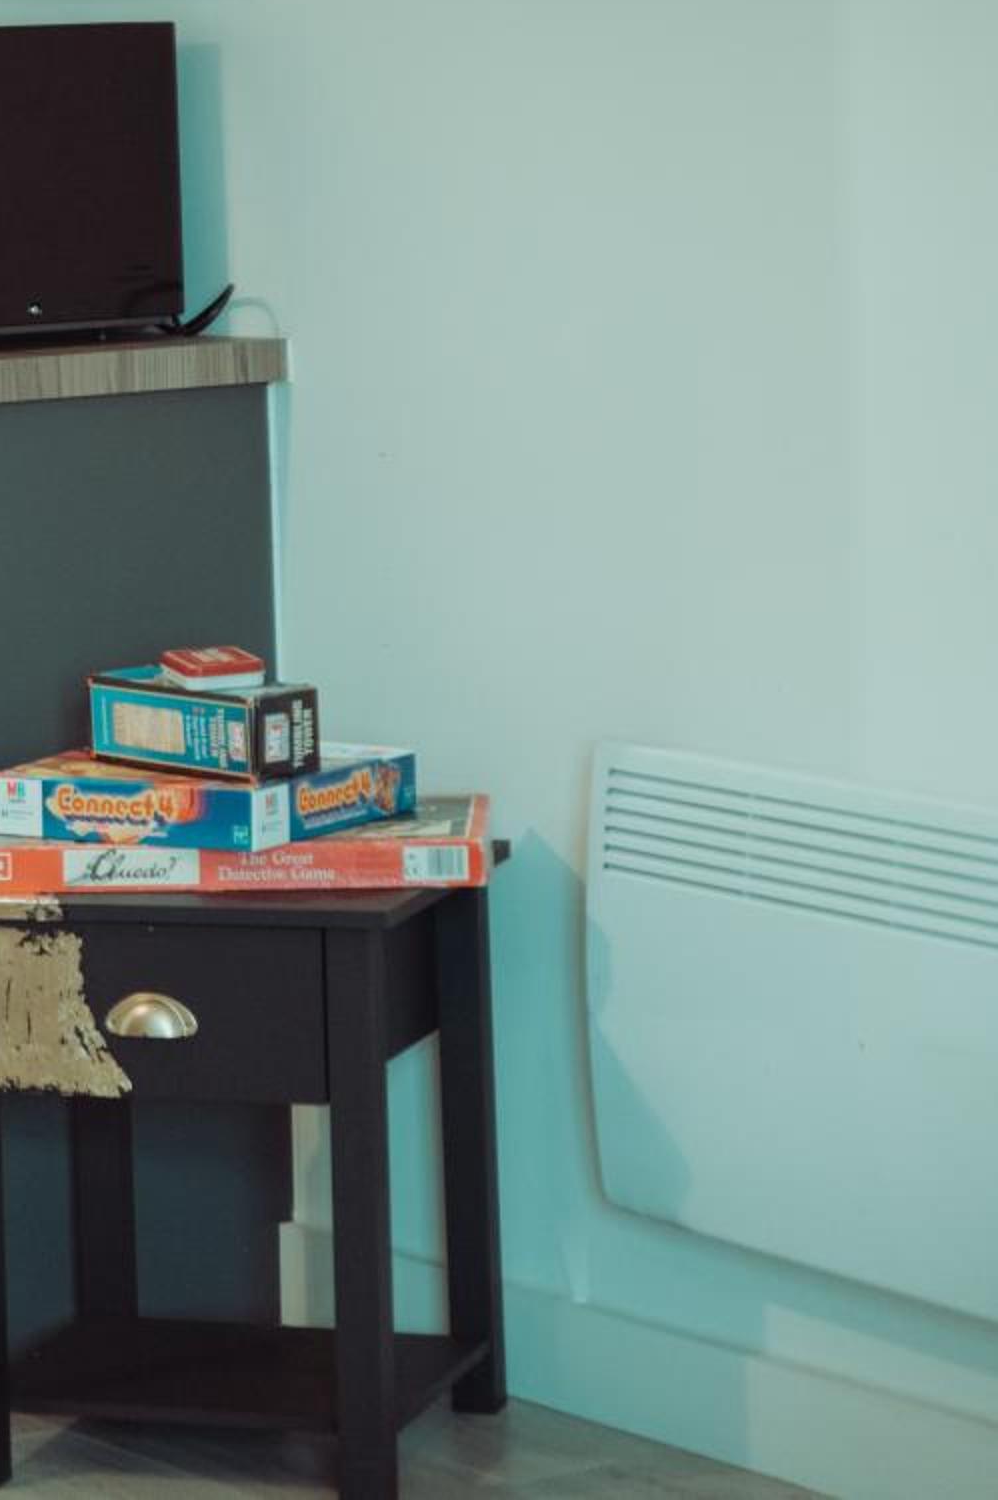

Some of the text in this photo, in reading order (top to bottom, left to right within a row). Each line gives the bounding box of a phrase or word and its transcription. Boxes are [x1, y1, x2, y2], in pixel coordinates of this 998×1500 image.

[57, 786, 155, 816] Connect
[158, 791, 174, 817] 4
[299, 773, 358, 812] Connect
[237, 851, 314, 866] The Great
[217, 866, 336, 882] Detective Game
